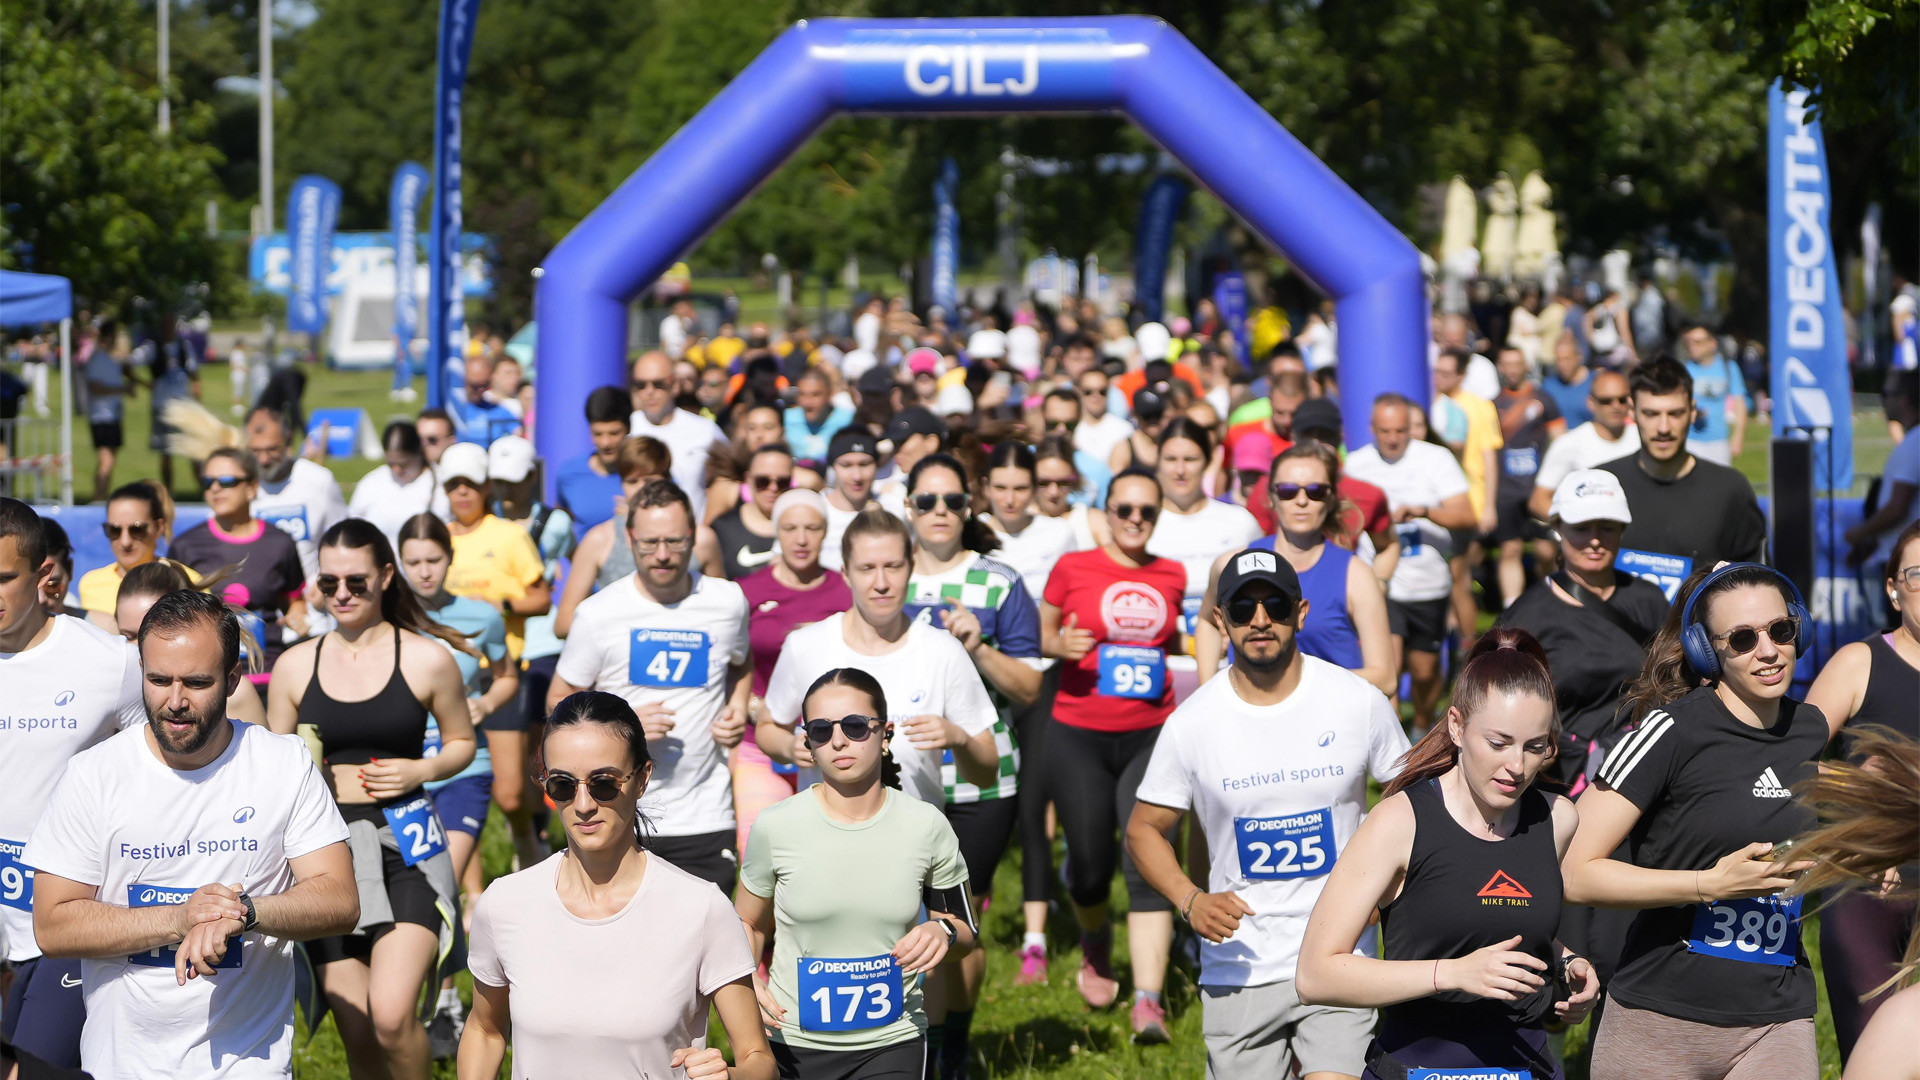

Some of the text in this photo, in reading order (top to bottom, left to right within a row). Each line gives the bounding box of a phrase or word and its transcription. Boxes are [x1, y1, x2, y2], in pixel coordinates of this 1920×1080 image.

[904, 44, 1039, 97] CILJ
[646, 650, 691, 682] 47
[1114, 663, 1152, 694] 95
[18, 716, 78, 732] sporta
[1222, 764, 1344, 791] Festival sporta
[1752, 785, 1792, 798] adidas
[1260, 813, 1322, 831] DECATHLON
[1284, 828, 1302, 836] Ready
[120, 837, 258, 860] Festival sporta
[402, 814, 445, 858] 24
[1247, 835, 1326, 874] 225
[1482, 898, 1530, 907] NIKE TRAIL
[1704, 906, 1788, 955] 389
[825, 957, 891, 973] DECATHLON
[850, 972, 869, 980] Ready
[877, 969, 892, 978] play?
[811, 982, 892, 1023] 173
